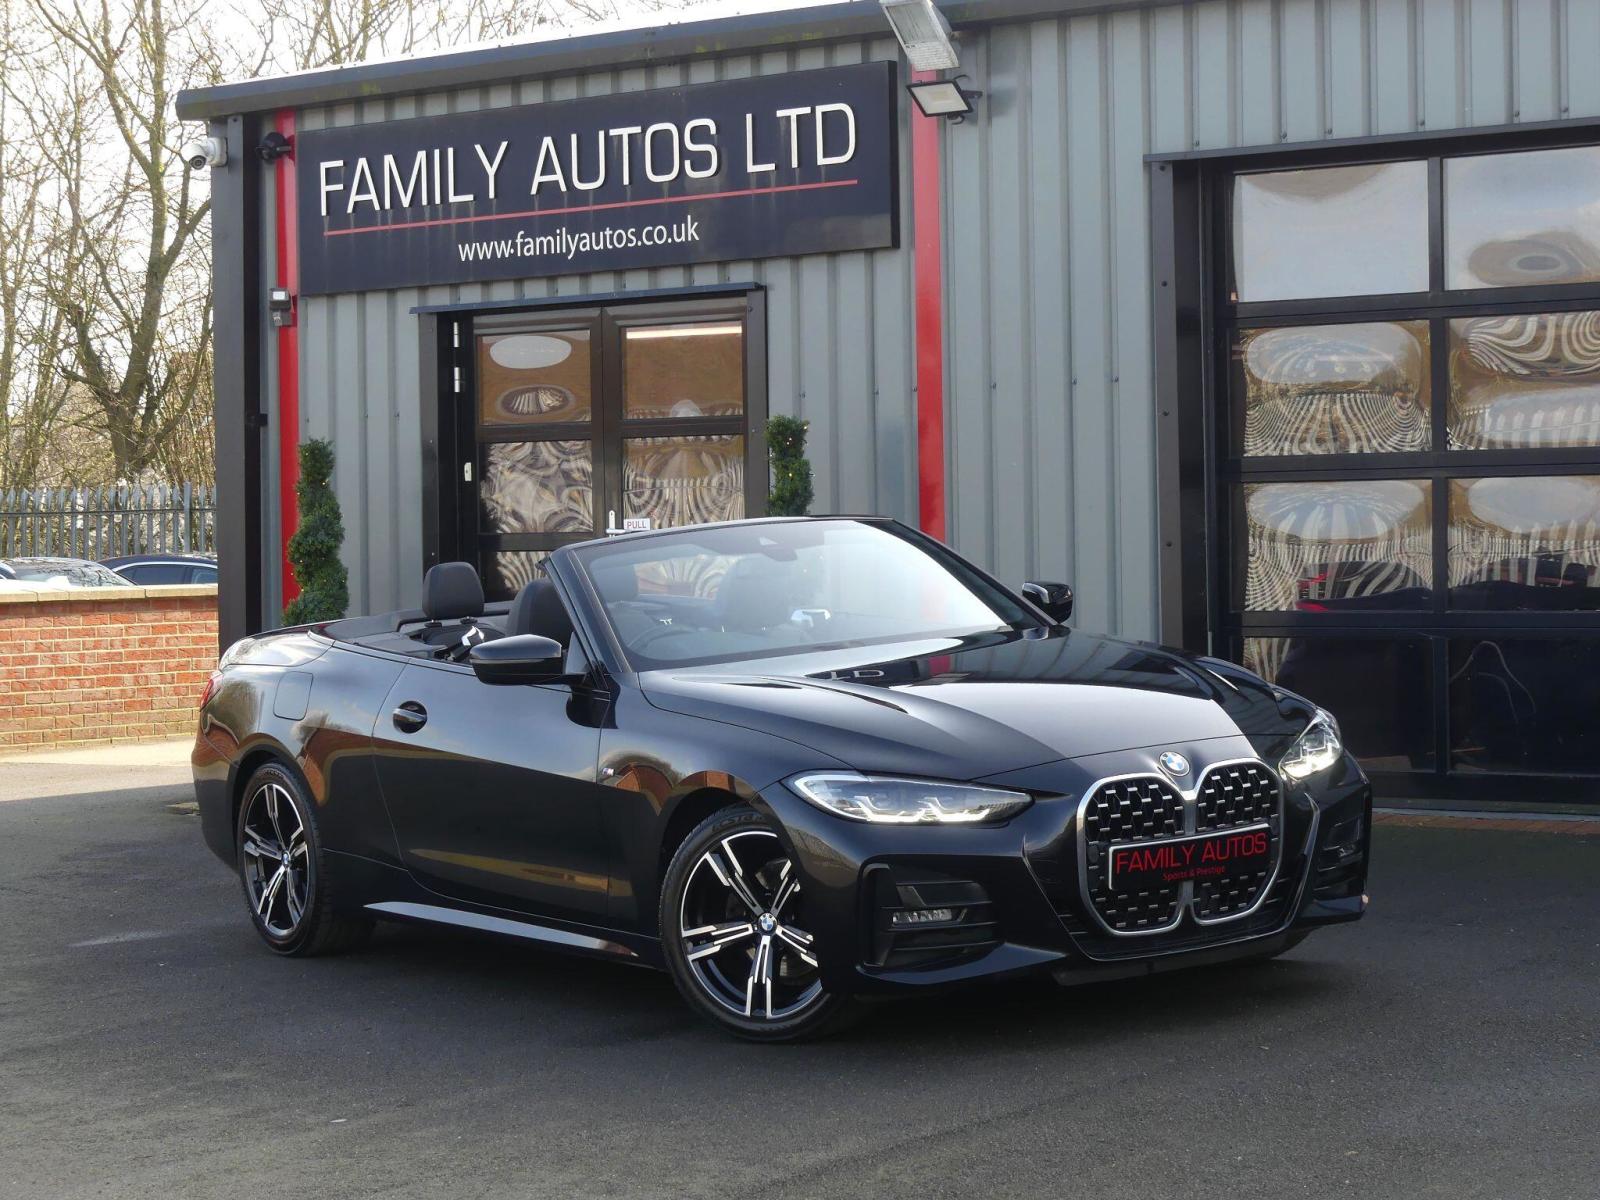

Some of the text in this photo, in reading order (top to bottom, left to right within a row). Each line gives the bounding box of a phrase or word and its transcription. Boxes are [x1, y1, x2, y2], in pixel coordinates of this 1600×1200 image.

[319, 102, 857, 217] FAMILY AUTOS LTD
[458, 214, 700, 261] www.familyautos.co.uk
[626, 520, 647, 529] PULL
[1115, 831, 1268, 875] FAMILY AUTOS
